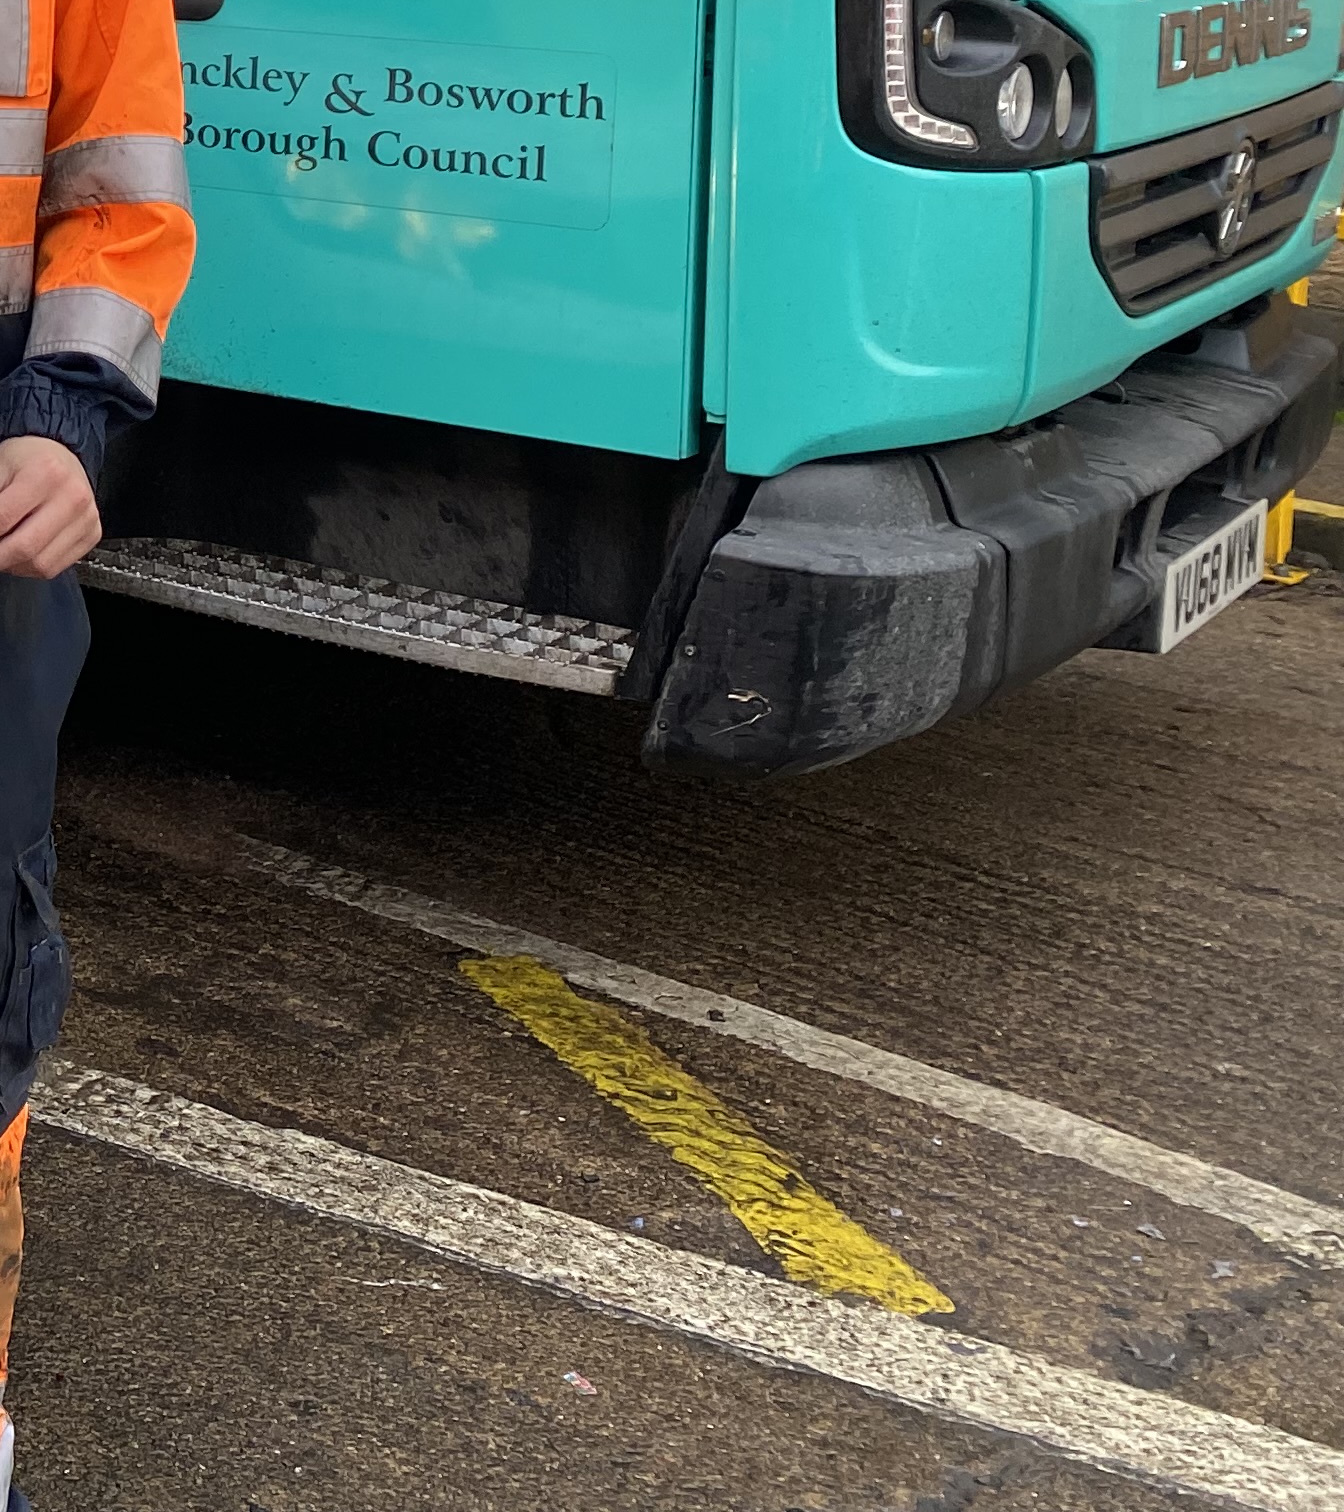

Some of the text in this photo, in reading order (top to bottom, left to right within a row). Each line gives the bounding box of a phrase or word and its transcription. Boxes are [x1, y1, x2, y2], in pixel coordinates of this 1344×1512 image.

[180, 54, 607, 121] nckley & Bosworth
[367, 130, 548, 183] Council
[1174, 543, 1223, 633] VU68
